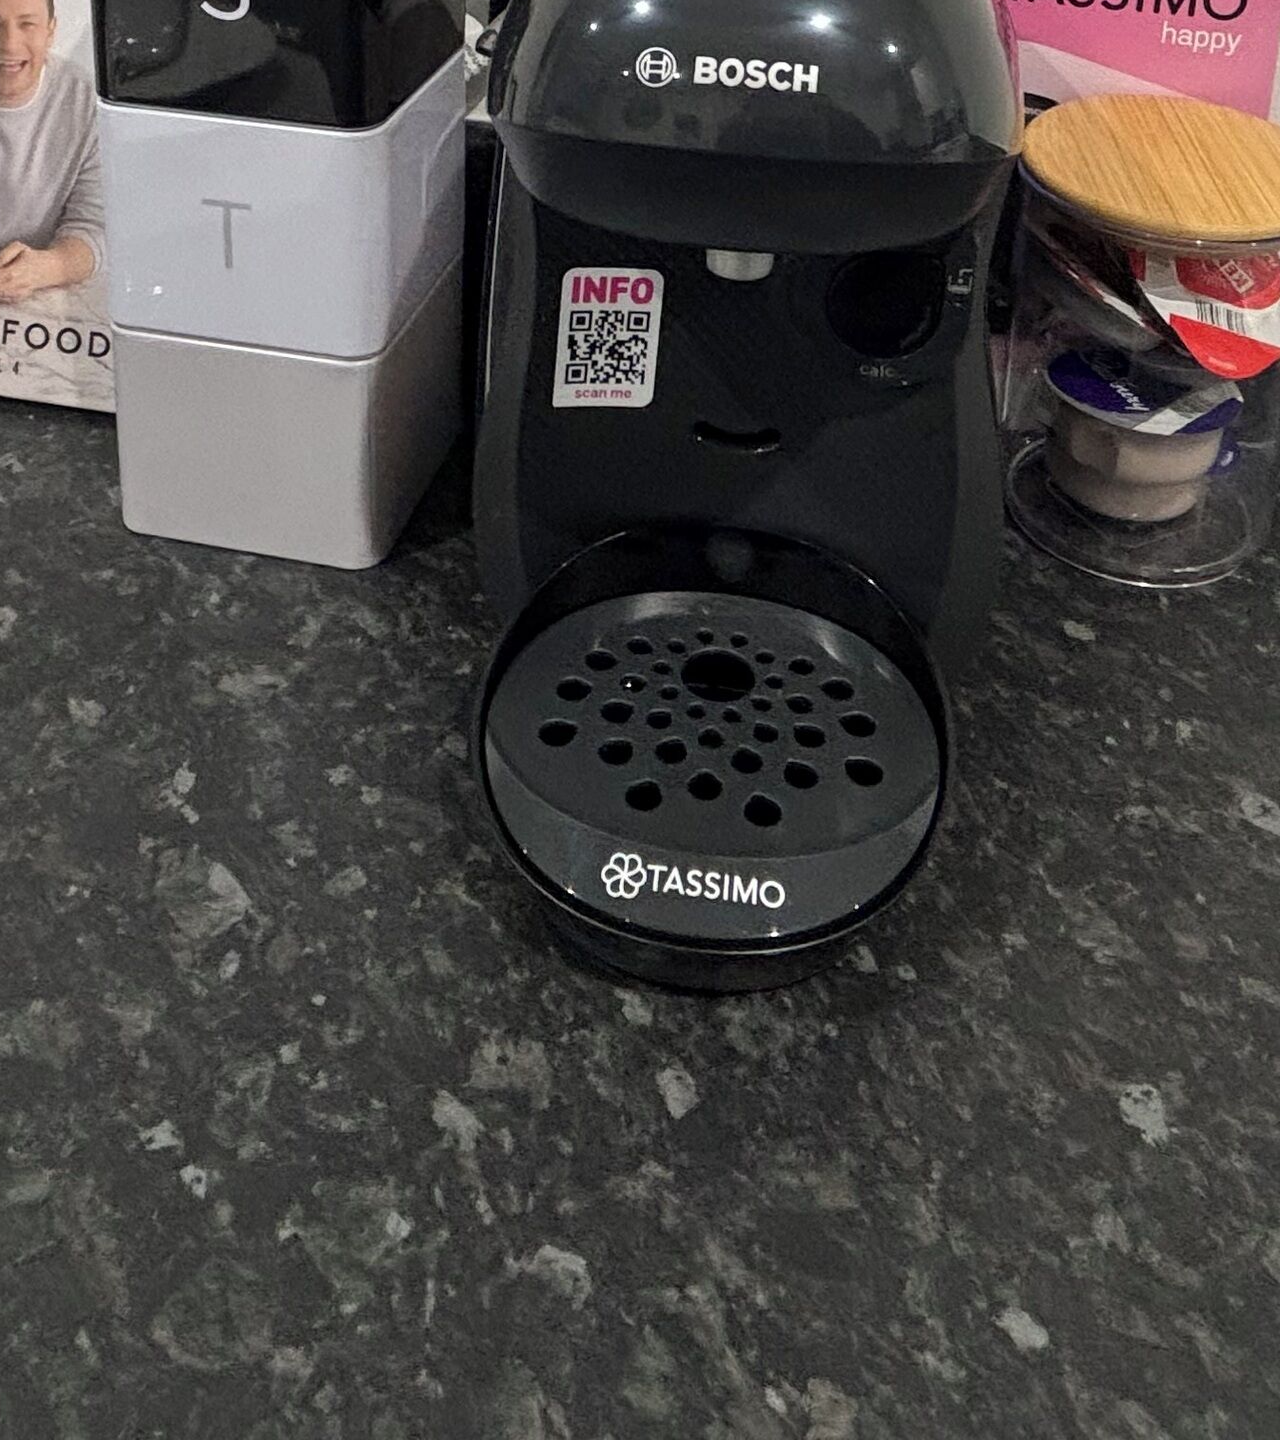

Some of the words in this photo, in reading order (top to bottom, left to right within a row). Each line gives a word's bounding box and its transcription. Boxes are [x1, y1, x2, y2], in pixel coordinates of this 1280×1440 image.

[1159, 20, 1243, 56] happy
[692, 55, 820, 94] BOSCH
[201, 197, 252, 269] T
[571, 276, 655, 305] INFO
[2, 318, 111, 358] FOOD
[11, 361, 20, 375] 4
[574, 389, 608, 399] scan
[609, 389, 633, 399] me
[646, 863, 786, 909] TASSIMO
